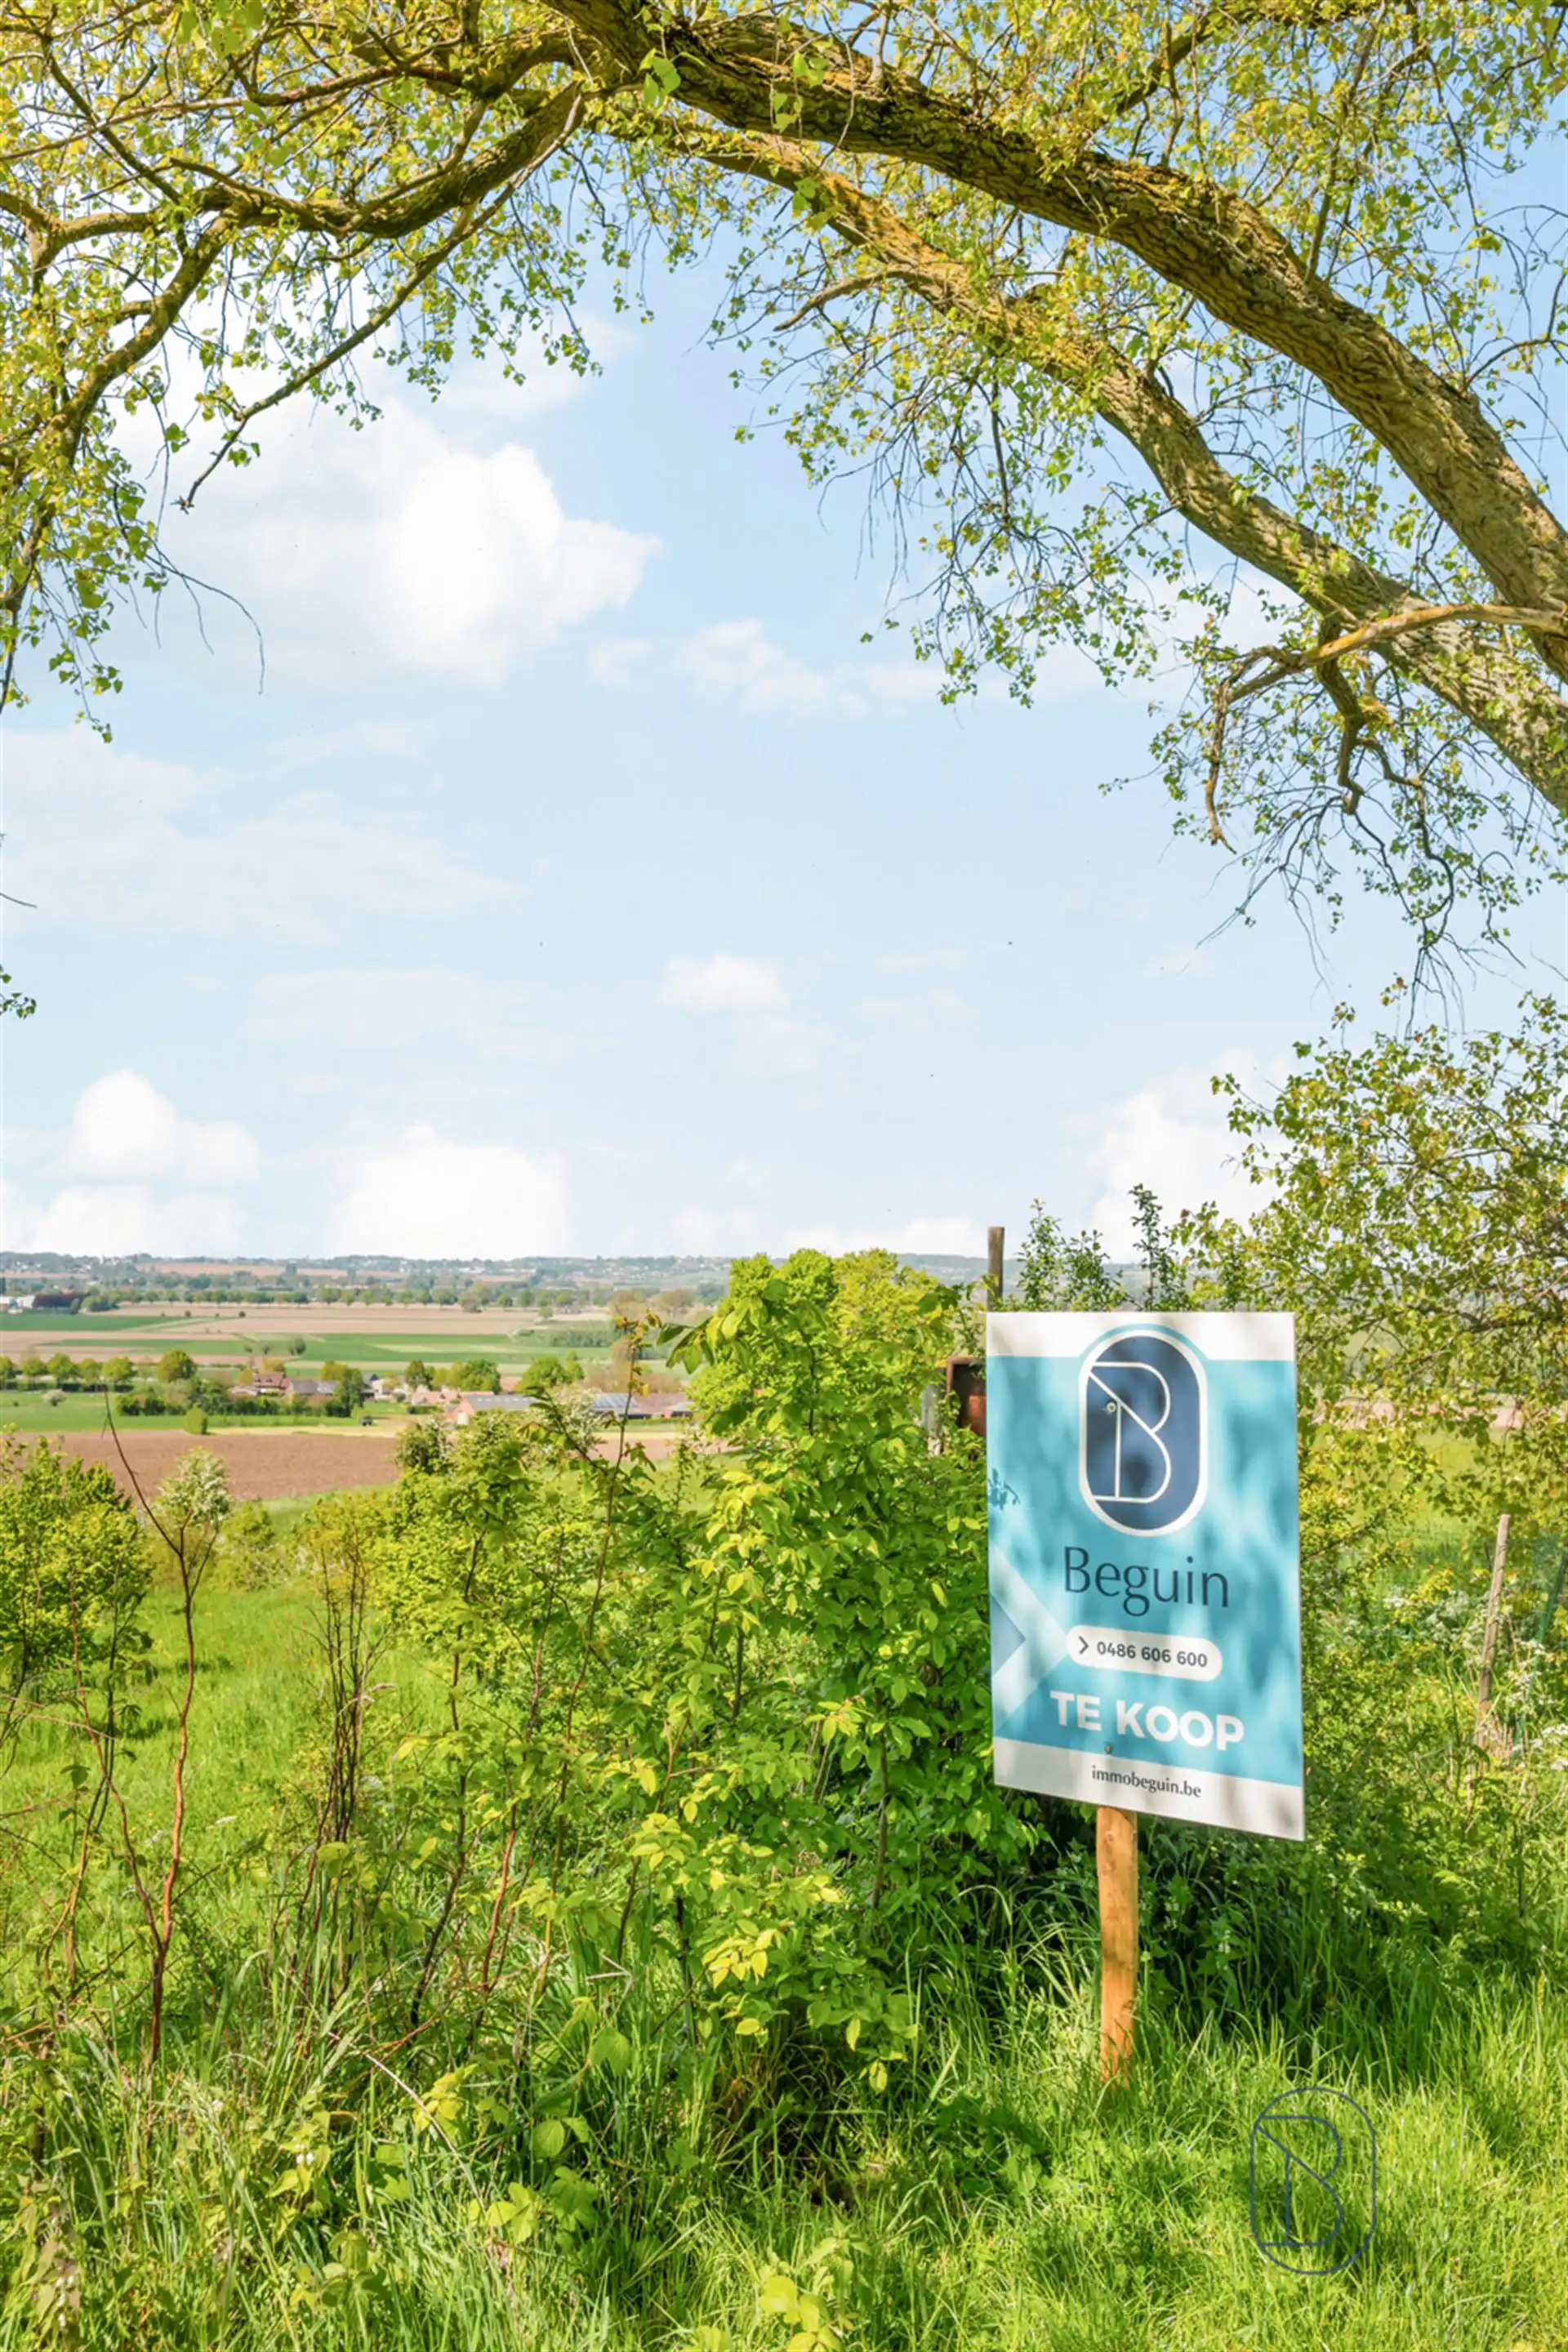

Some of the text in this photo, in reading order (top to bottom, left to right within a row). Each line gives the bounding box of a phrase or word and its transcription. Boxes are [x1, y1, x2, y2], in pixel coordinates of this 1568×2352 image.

[1063, 1546, 1229, 1617] Beguin
[1096, 1641, 1208, 1668] 0486 606 600
[1049, 1690, 1245, 1752] TE KOOP
[1091, 1765, 1202, 1798] immobeguin.be
